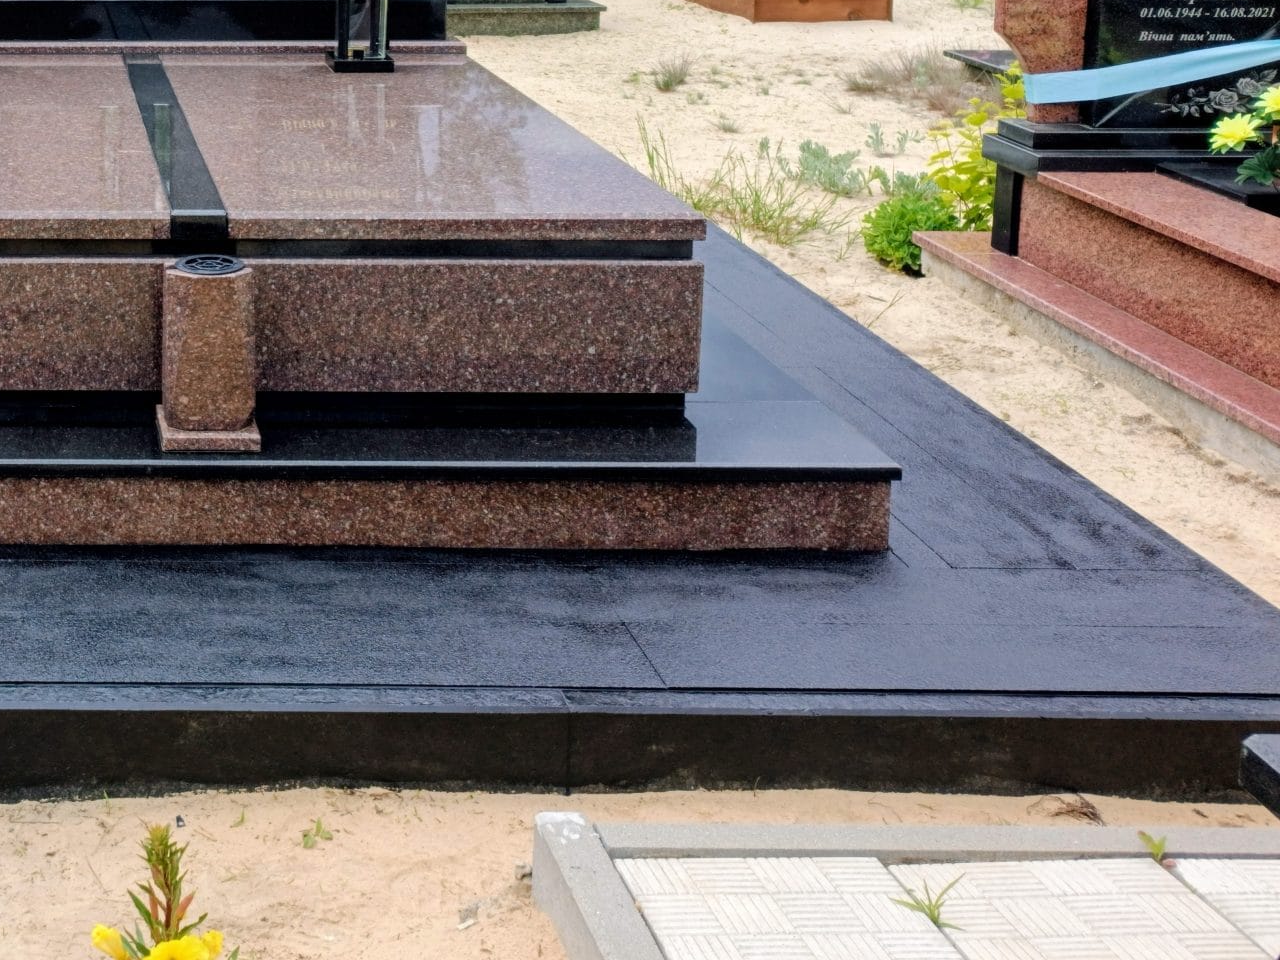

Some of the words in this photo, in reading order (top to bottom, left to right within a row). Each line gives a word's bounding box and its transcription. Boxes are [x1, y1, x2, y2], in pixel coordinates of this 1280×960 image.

[1140, 7, 1202, 18] 01.06.1944
[1213, 7, 1276, 18] 16.08.2021
[1139, 31, 1174, 41] Вічна
